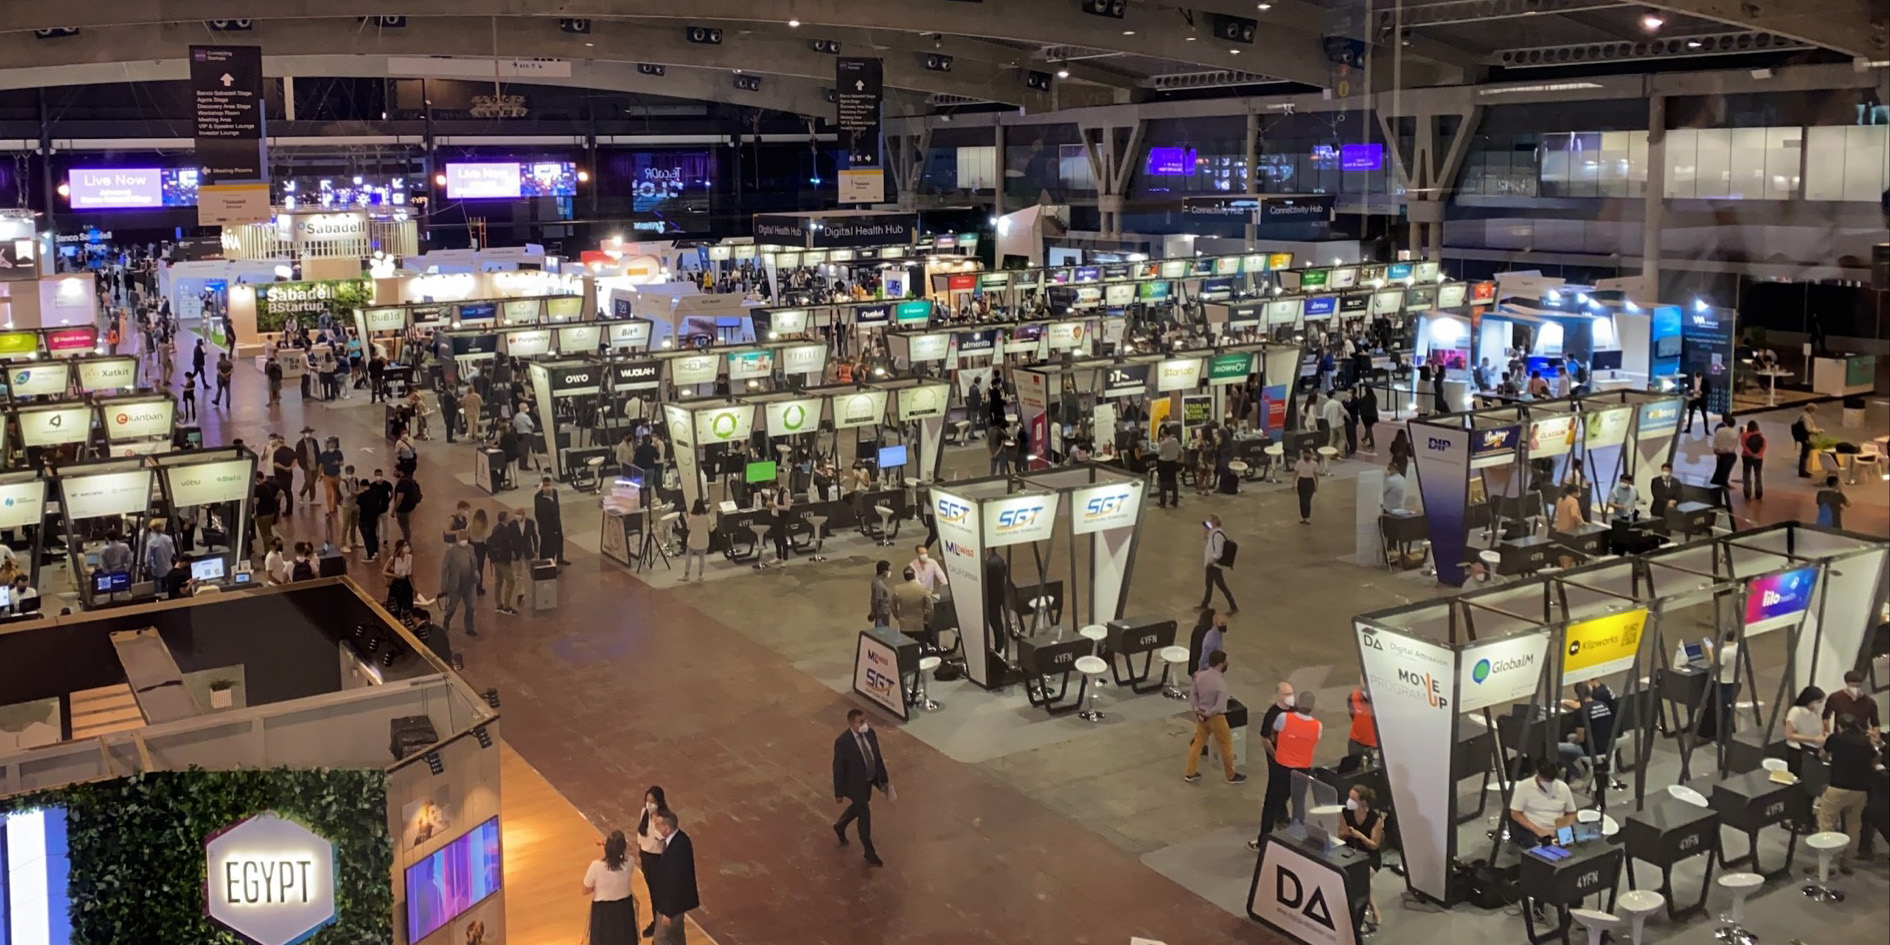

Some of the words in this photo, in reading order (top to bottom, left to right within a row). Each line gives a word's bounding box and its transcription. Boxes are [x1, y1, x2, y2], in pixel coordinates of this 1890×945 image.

[84, 174, 112, 186] Live
[115, 174, 146, 186] Now
[458, 168, 481, 179] Live
[1191, 205, 1229, 216] Connectivity
[1230, 205, 1244, 215] Hub
[1270, 205, 1308, 216] Connectivity
[1310, 204, 1323, 213] Hub
[307, 221, 365, 235] Sabadell
[758, 225, 774, 235] Digital
[774, 225, 790, 235] Health
[790, 226, 802, 236] Hub
[824, 225, 853, 238] Digital
[855, 225, 884, 236] Health
[886, 224, 904, 235] Hub
[267, 286, 334, 302] Sabadell
[102, 368, 129, 377] Xatkit
[620, 367, 655, 378] WUOLAH
[1428, 436, 1451, 451] DIP
[1087, 494, 1129, 514] SGT
[938, 499, 970, 525] SGT
[999, 506, 1044, 528] SGT
[1762, 590, 1780, 607] lilo
[1140, 634, 1158, 646] 4YFN
[1389, 642, 1413, 656] Digital
[1054, 652, 1073, 664] 4YFN
[1492, 653, 1534, 674] GlobalM
[866, 667, 895, 697] SGT
[1398, 668, 1441, 694] MOVE
[1766, 801, 1785, 817] 4YFN
[1679, 834, 1699, 851] 4YFN
[225, 860, 312, 904] EGYPT
[1576, 871, 1598, 889] 4YFN
